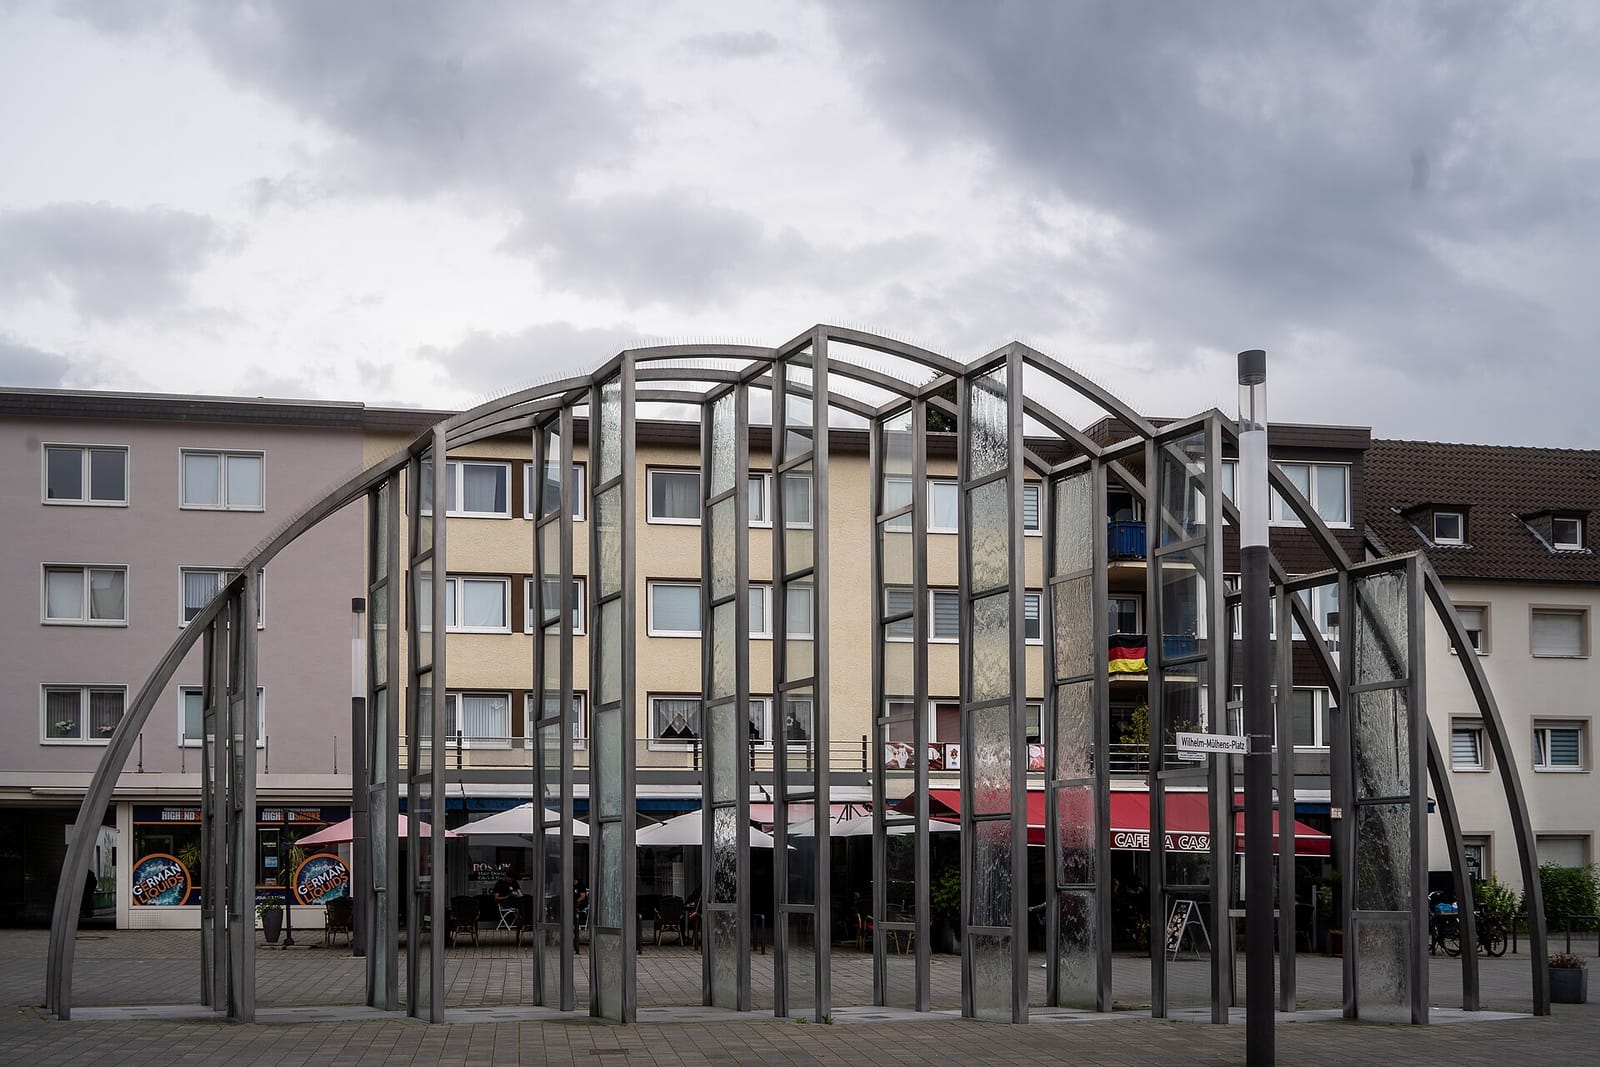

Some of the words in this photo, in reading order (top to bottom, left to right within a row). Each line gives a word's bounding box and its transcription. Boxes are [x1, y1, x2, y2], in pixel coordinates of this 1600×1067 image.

[1181, 736, 1245, 750] Wilhelm-Mülhens-Platz
[1114, 833, 1150, 848] CAFE
[1164, 834, 1175, 849] A
[132, 863, 182, 896] GERMAN
[138, 873, 185, 904] LIQUIDS
[298, 862, 346, 896] GERMAN
[304, 873, 349, 903] LIQUIDS
